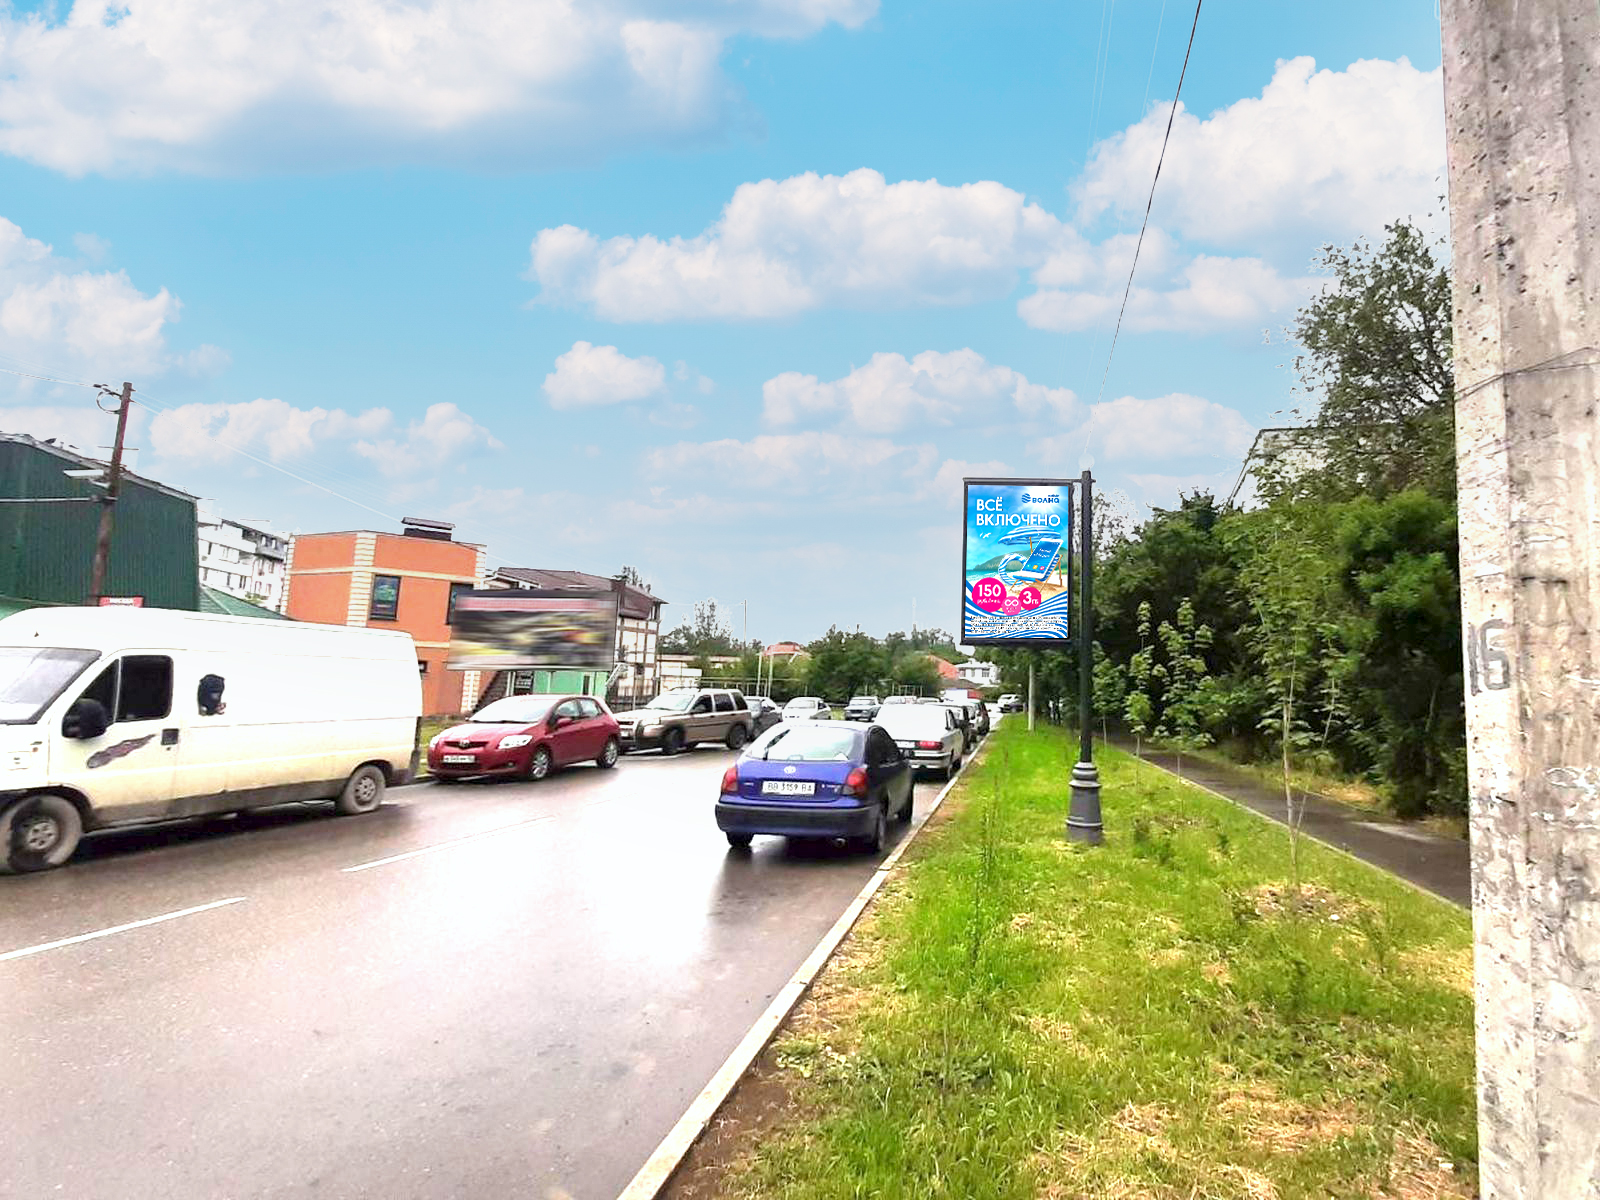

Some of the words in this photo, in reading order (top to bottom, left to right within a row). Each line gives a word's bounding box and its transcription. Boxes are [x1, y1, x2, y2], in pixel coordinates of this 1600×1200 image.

[976, 496, 1003, 511] ВСЁ
[976, 513, 1061, 526] ВКЛЮЧЕНО
[978, 584, 1001, 597] 150
[1467, 618, 1511, 696] 16
